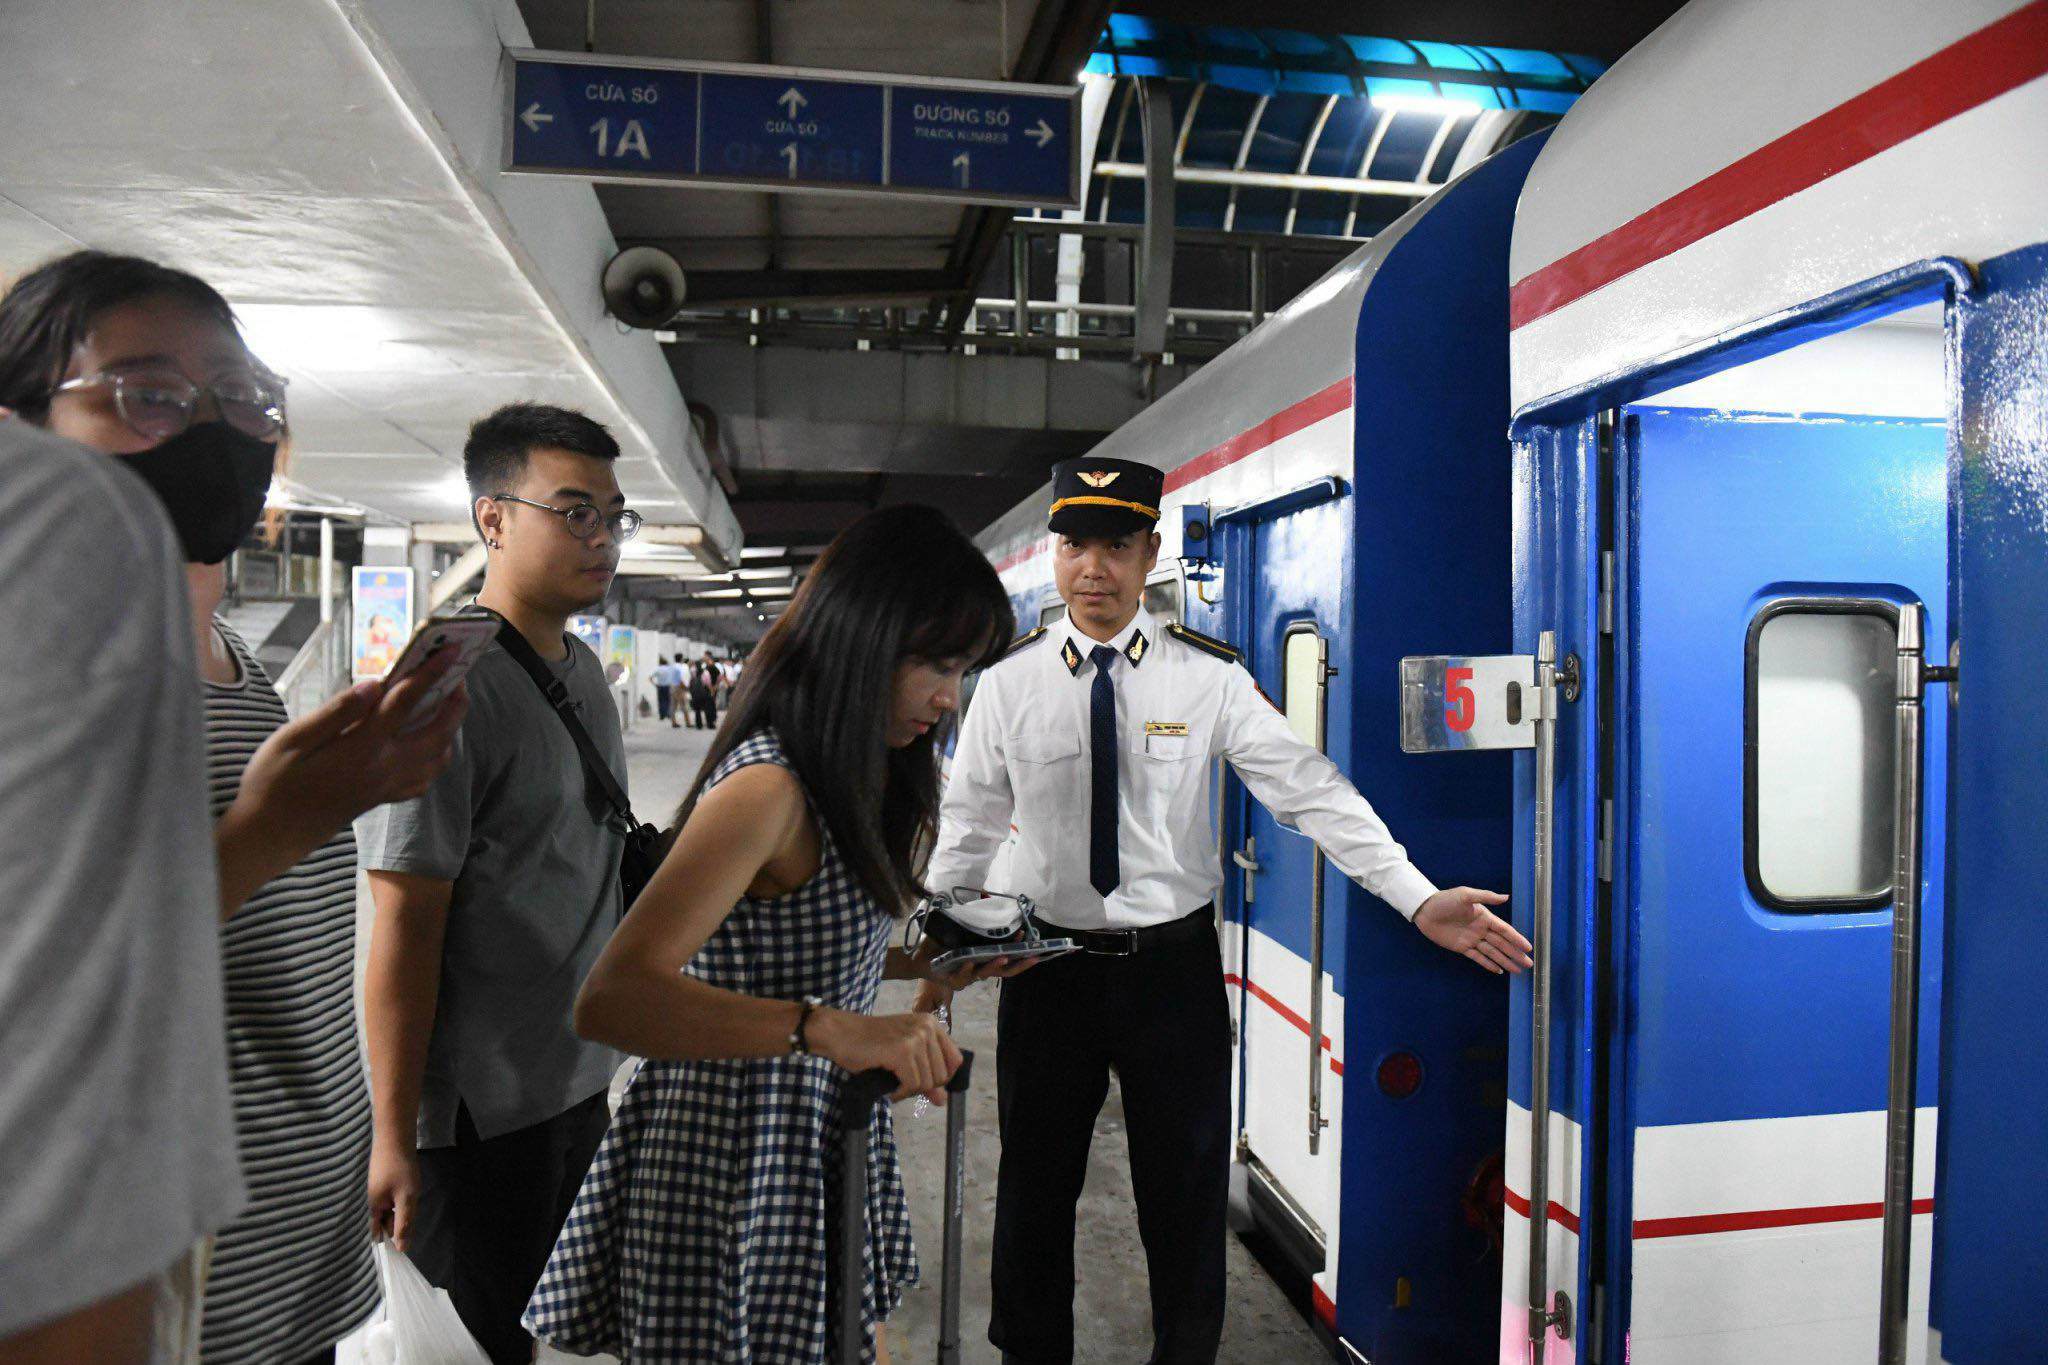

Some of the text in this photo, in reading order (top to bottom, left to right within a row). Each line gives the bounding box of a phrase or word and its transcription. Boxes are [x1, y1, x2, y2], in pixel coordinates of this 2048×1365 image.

[589, 117, 651, 160] 1A
[780, 142, 797, 179] 1
[953, 152, 970, 189] 1
[1445, 668, 1476, 732] 5
